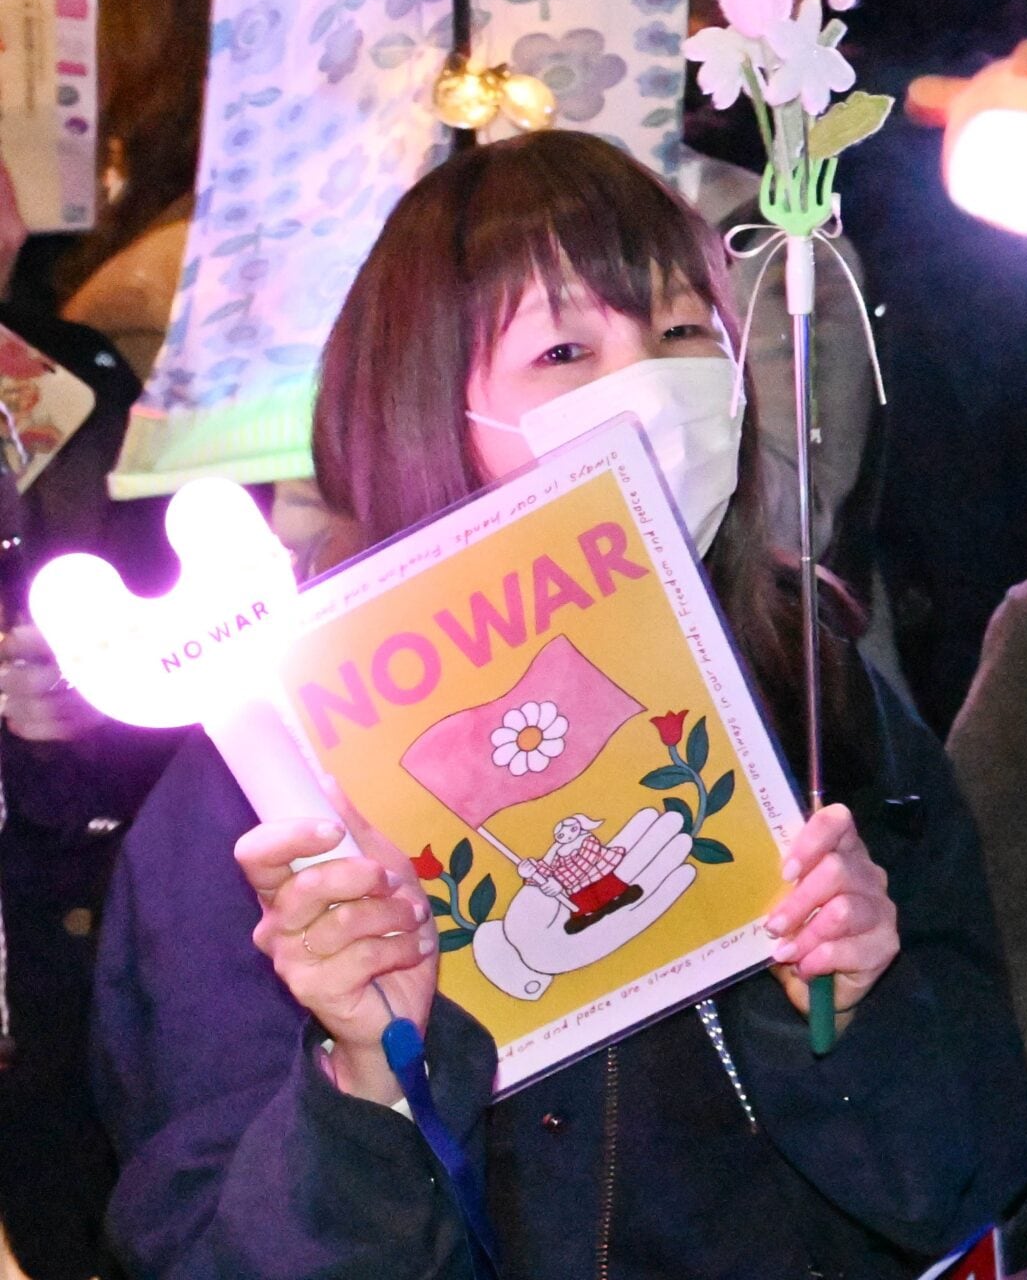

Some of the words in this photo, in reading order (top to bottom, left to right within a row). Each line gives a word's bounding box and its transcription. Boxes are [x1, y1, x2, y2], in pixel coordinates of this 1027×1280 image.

[568, 450, 618, 482] always
[616, 463, 631, 483] are
[542, 479, 559, 495] in
[508, 493, 537, 516] our
[628, 489, 653, 524] peace
[454, 510, 501, 545] hands
[642, 529, 664, 554] and
[660, 559, 690, 617] Freedom
[161, 641, 202, 673] NO
[208, 601, 269, 642] WAR
[299, 631, 442, 750] NO
[433, 522, 650, 668] WAR
[686, 625, 711, 663] hands
[705, 669, 723, 692] our
[719, 695, 731, 709] in
[726, 716, 749, 757] always
[746, 761, 760, 780] are
[758, 786, 782, 819] peace
[542, 1018, 569, 1040] and
[575, 999, 612, 1026] peace
[619, 984, 640, 999] are
[647, 958, 692, 985] always
[700, 947, 715, 962] in
[719, 930, 745, 950] our
